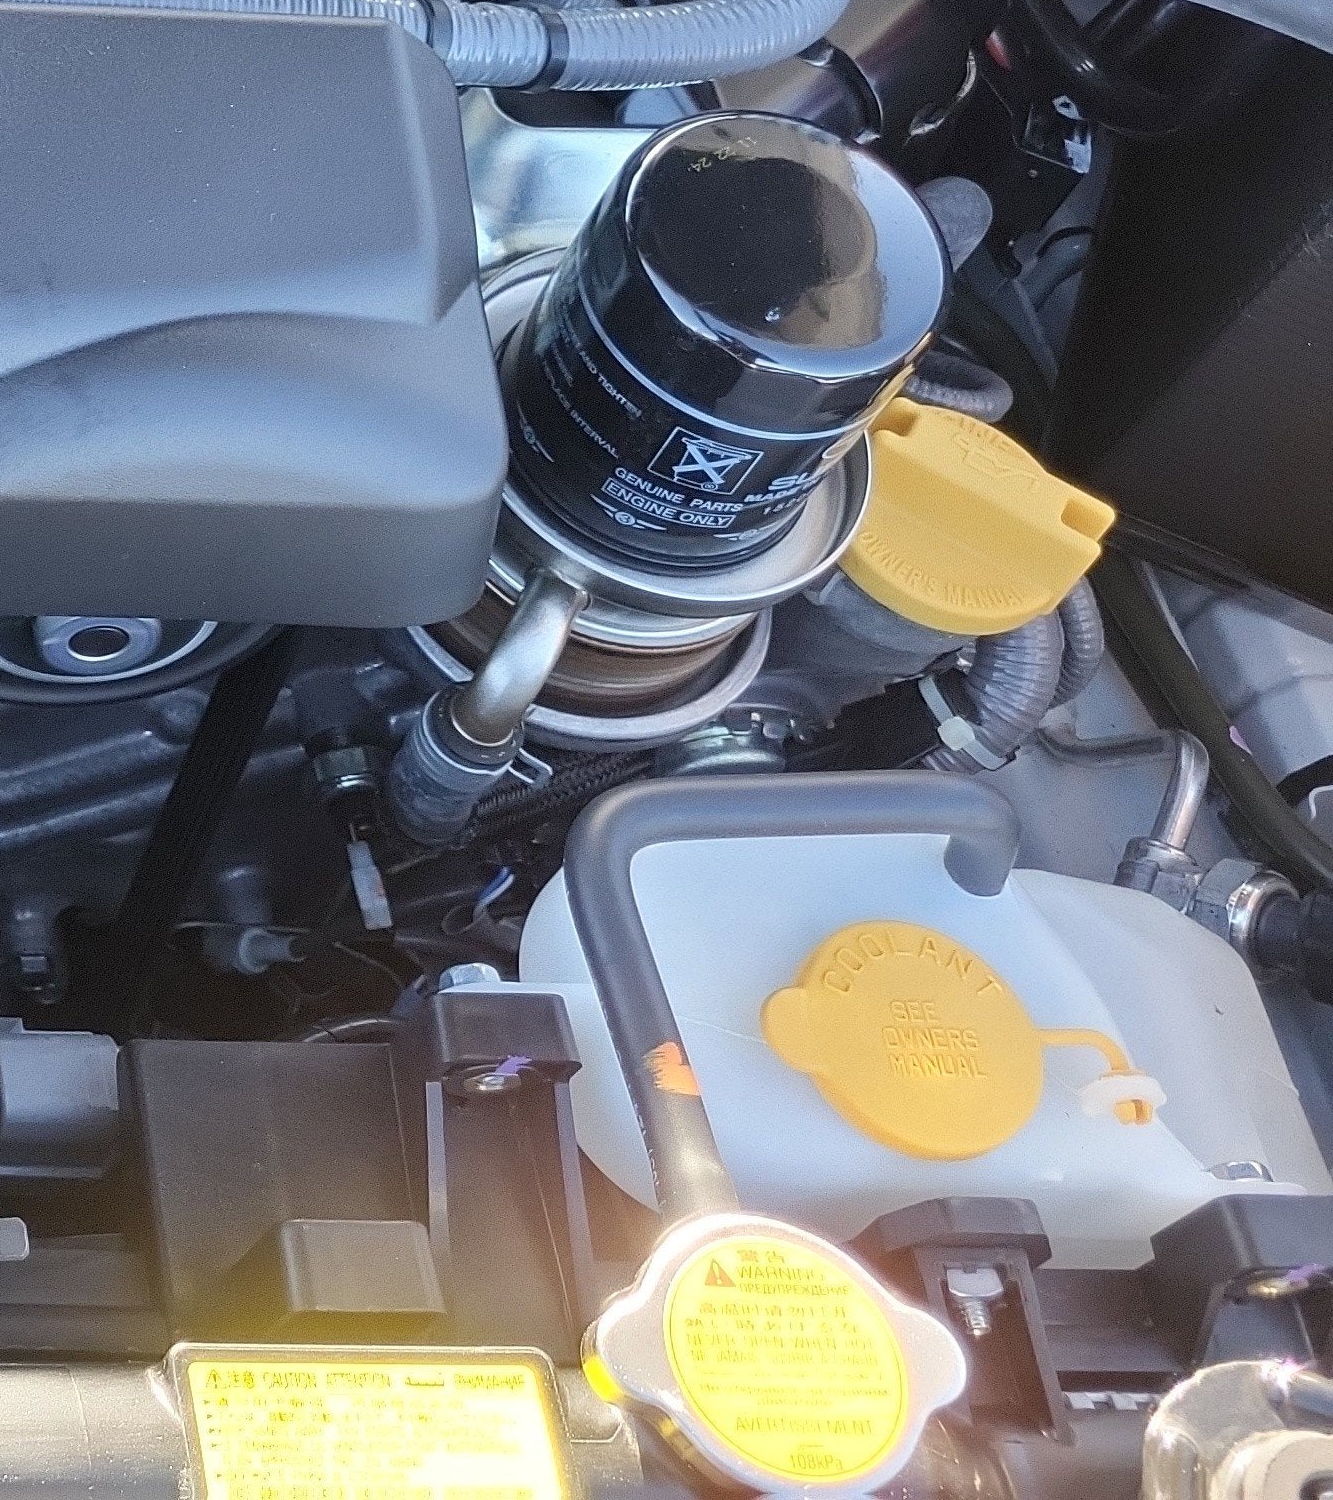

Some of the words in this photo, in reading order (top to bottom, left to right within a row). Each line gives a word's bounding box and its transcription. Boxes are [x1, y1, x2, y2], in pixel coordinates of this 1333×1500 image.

[570, 406, 620, 459] INTERVAL
[606, 482, 678, 519] ENGINE
[679, 512, 731, 527] ONLY
[614, 466, 685, 504] GENUINE
[689, 498, 744, 513] PARTS
[819, 930, 1003, 998] COOLANT
[889, 1000, 939, 1024] SEE
[882, 1026, 978, 1050] OWNERS
[889, 1053, 988, 1080] MANUAL
[789, 1453, 844, 1471] 108kPa
